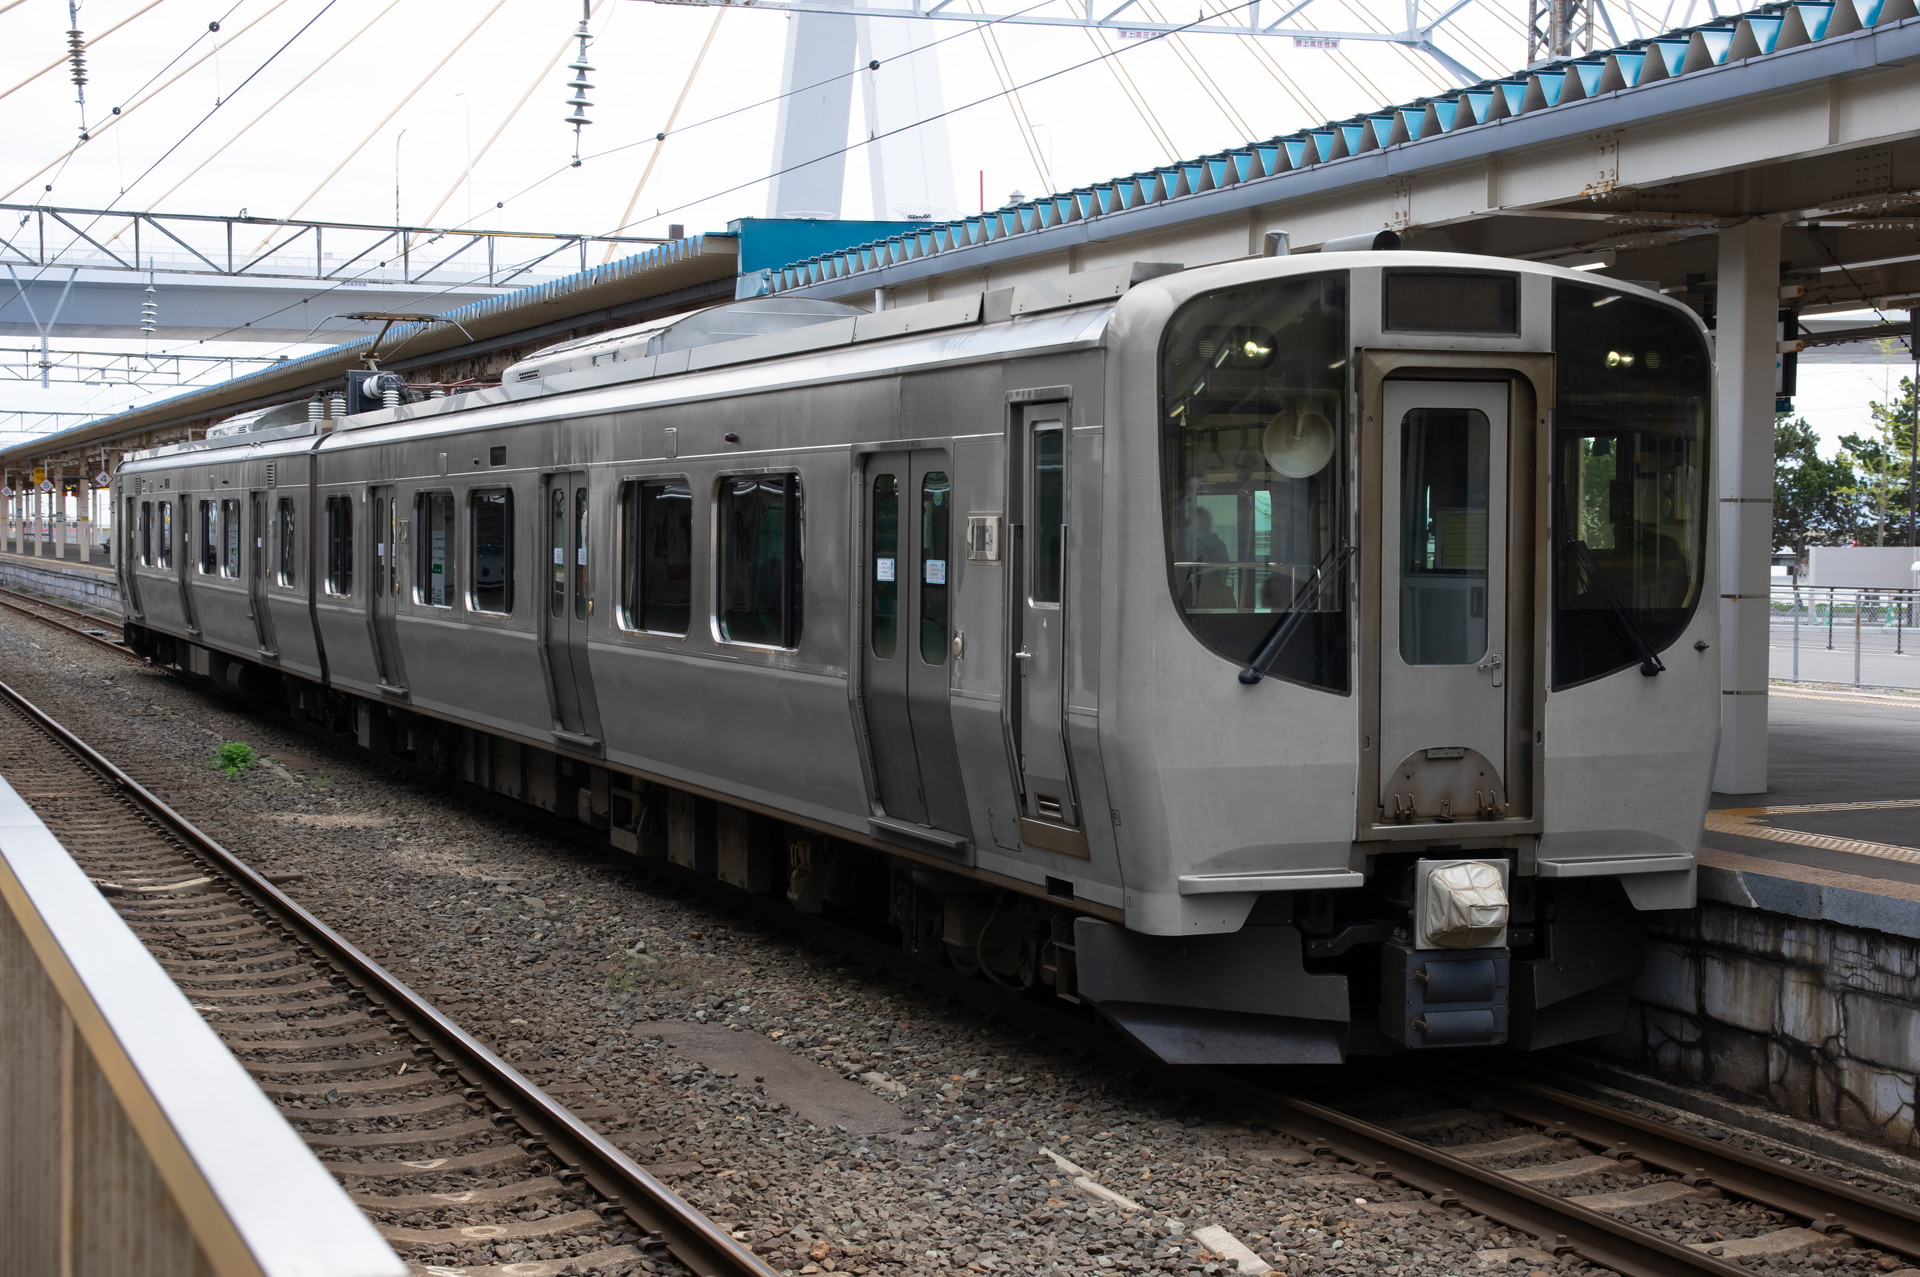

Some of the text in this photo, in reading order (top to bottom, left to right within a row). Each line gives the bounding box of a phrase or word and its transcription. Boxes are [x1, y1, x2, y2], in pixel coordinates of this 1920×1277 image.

[1296, 40, 1338, 48] 頭上高圧危険
